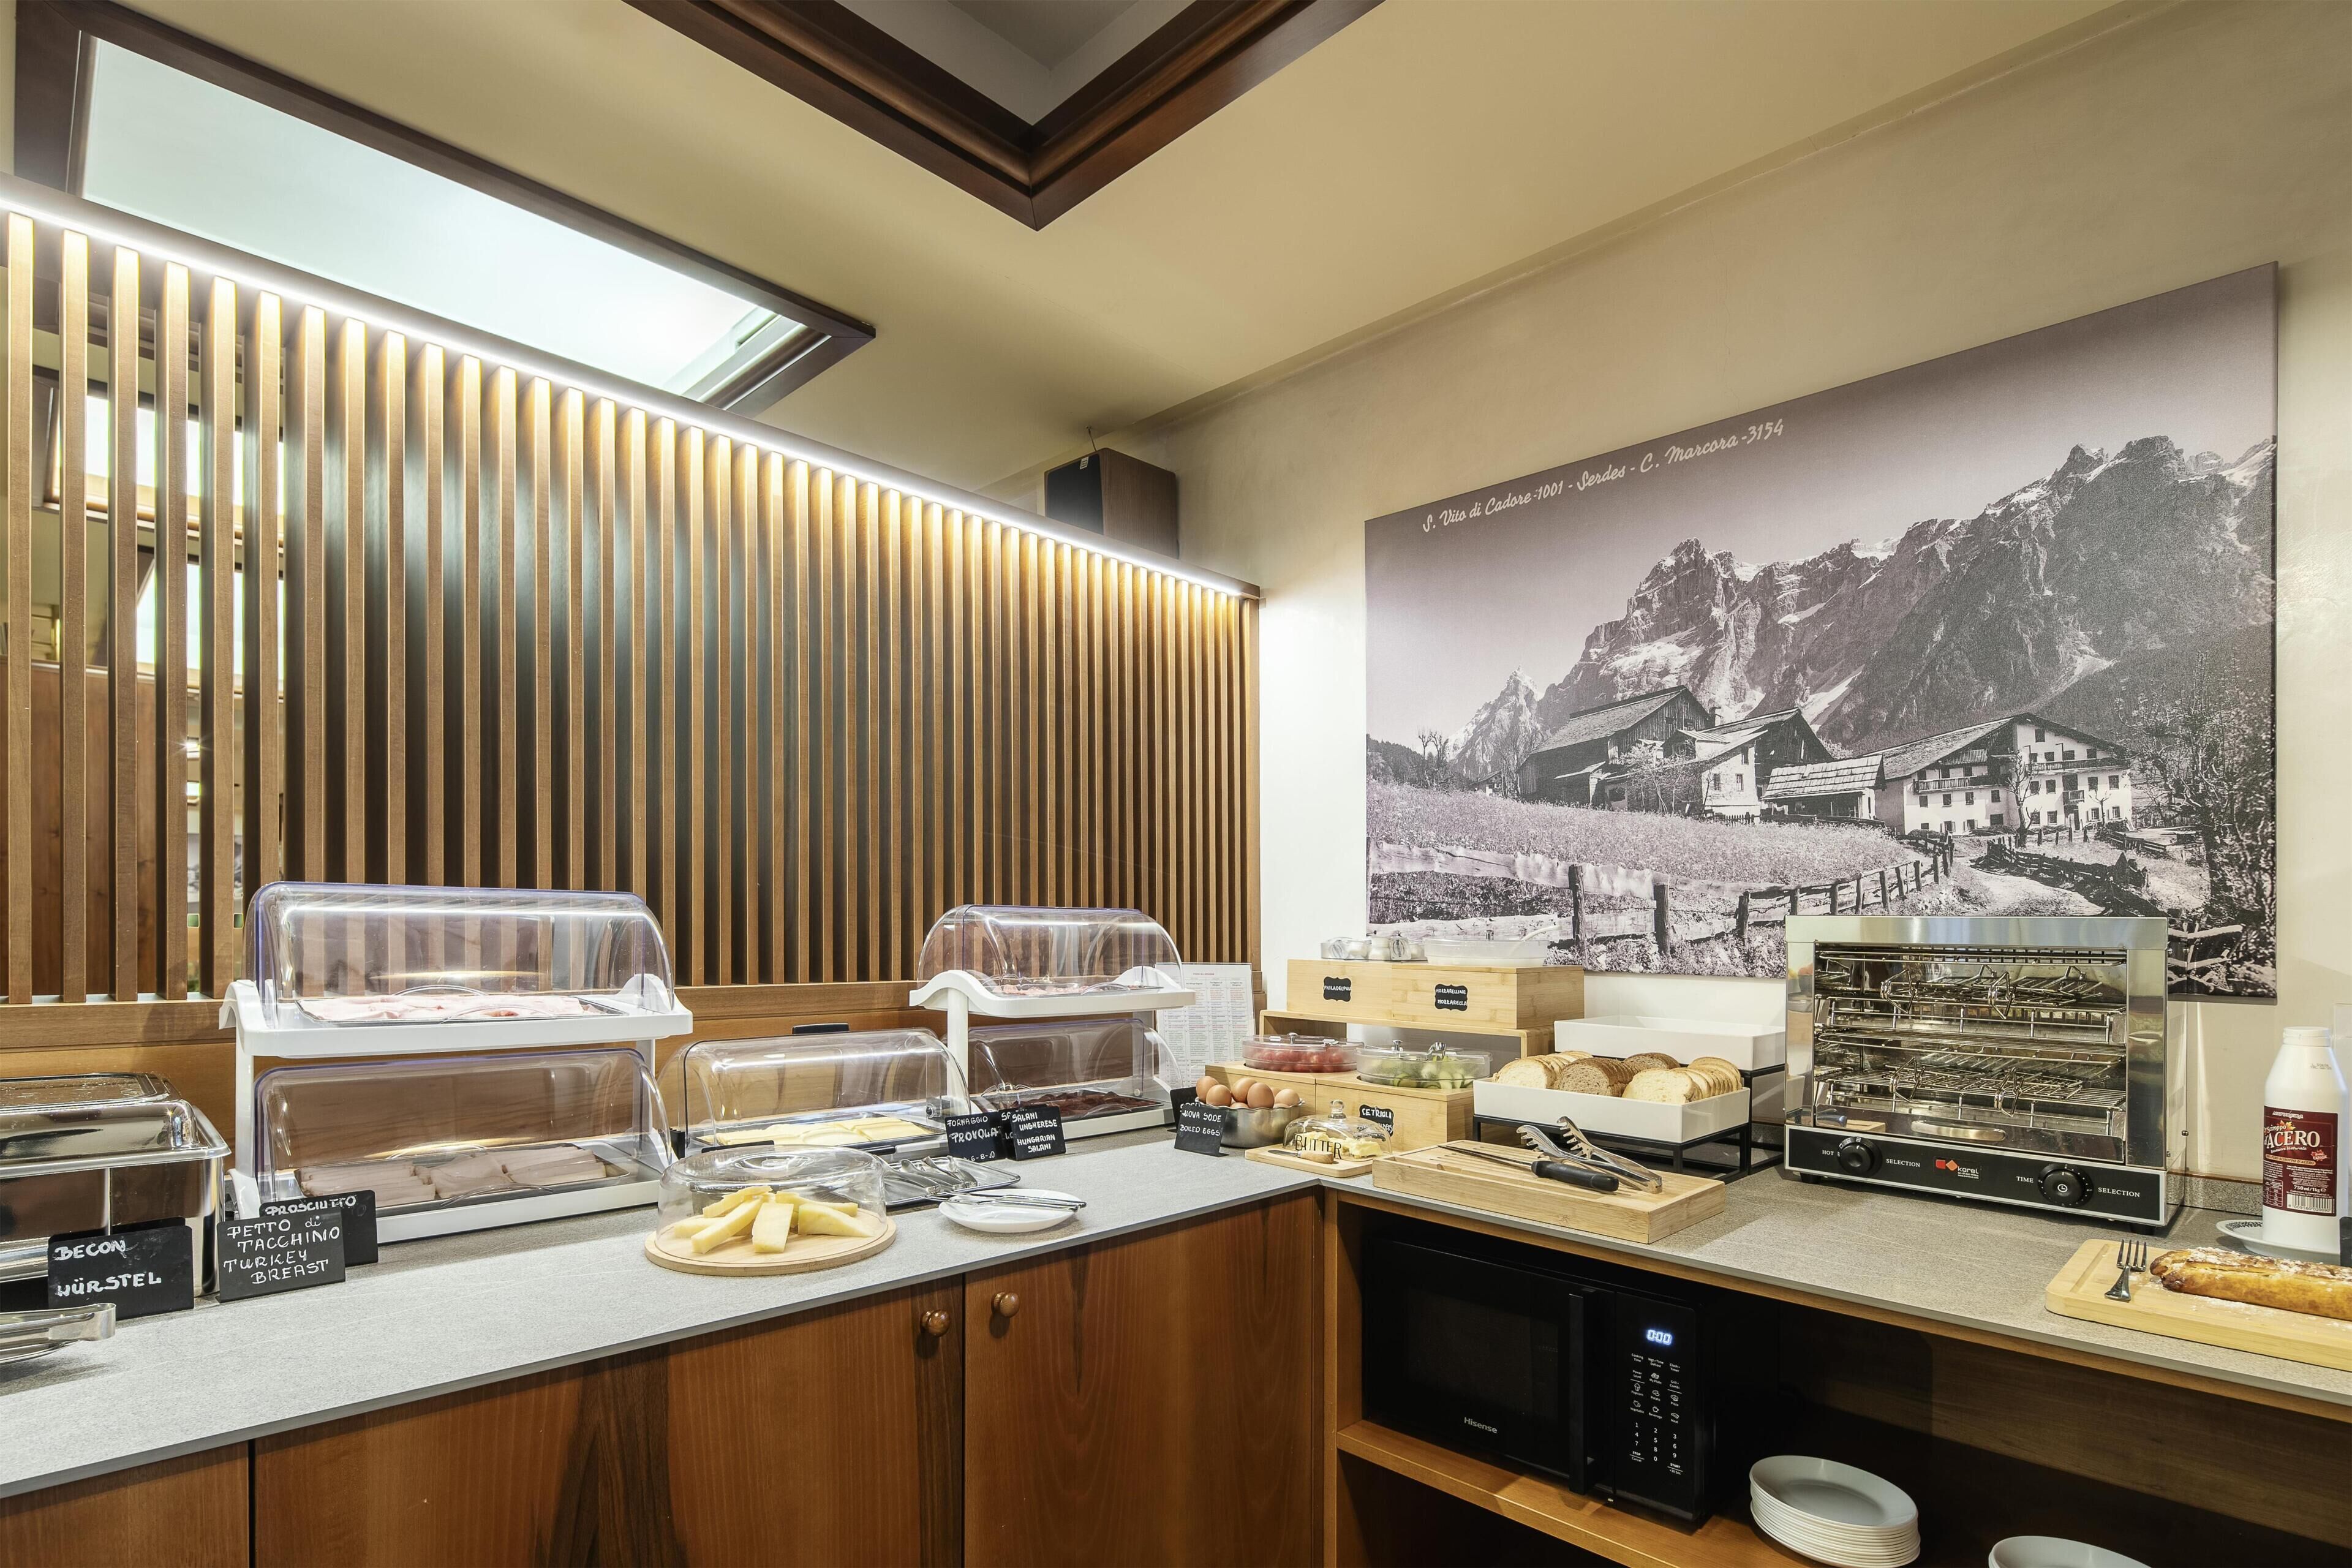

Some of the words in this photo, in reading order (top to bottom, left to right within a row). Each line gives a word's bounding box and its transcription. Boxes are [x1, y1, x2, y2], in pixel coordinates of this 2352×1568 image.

[1423, 514, 1436, 532] S.
[1439, 509, 1466, 526] Vito
[1469, 502, 1482, 518] di
[1577, 464, 1626, 491] Serdes
[1640, 453, 1659, 473] C.
[1665, 435, 1738, 464] Marcora
[1203, 1112, 1221, 1123] SODE
[1362, 1108, 1392, 1119] CETRIOLI
[1019, 1119, 1058, 1131] UNGHERESE
[1180, 1124, 1200, 1133] BOILED
[1202, 1127, 1220, 1136] EGGS
[950, 1128, 998, 1144] PROVOLA
[1017, 1134, 1055, 1146] HUNGARIAN
[1295, 1135, 1342, 1159] BUTTER
[1886, 1158, 1921, 1167] SELECTION
[2098, 1187, 2140, 1197] SELECTION
[265, 1195, 356, 1216] PROSCIUTTO
[227, 1219, 290, 1239] PETTO
[304, 1215, 322, 1227] di
[237, 1226, 340, 1253] TACCHINO
[54, 1240, 126, 1261] BECON
[223, 1249, 307, 1273] TURKEY
[251, 1259, 329, 1284] BREAST
[56, 1272, 162, 1297] WÜRSTEL
[1646, 1329, 1673, 1345] 0:00
[1464, 1417, 1498, 1433] Hisense
